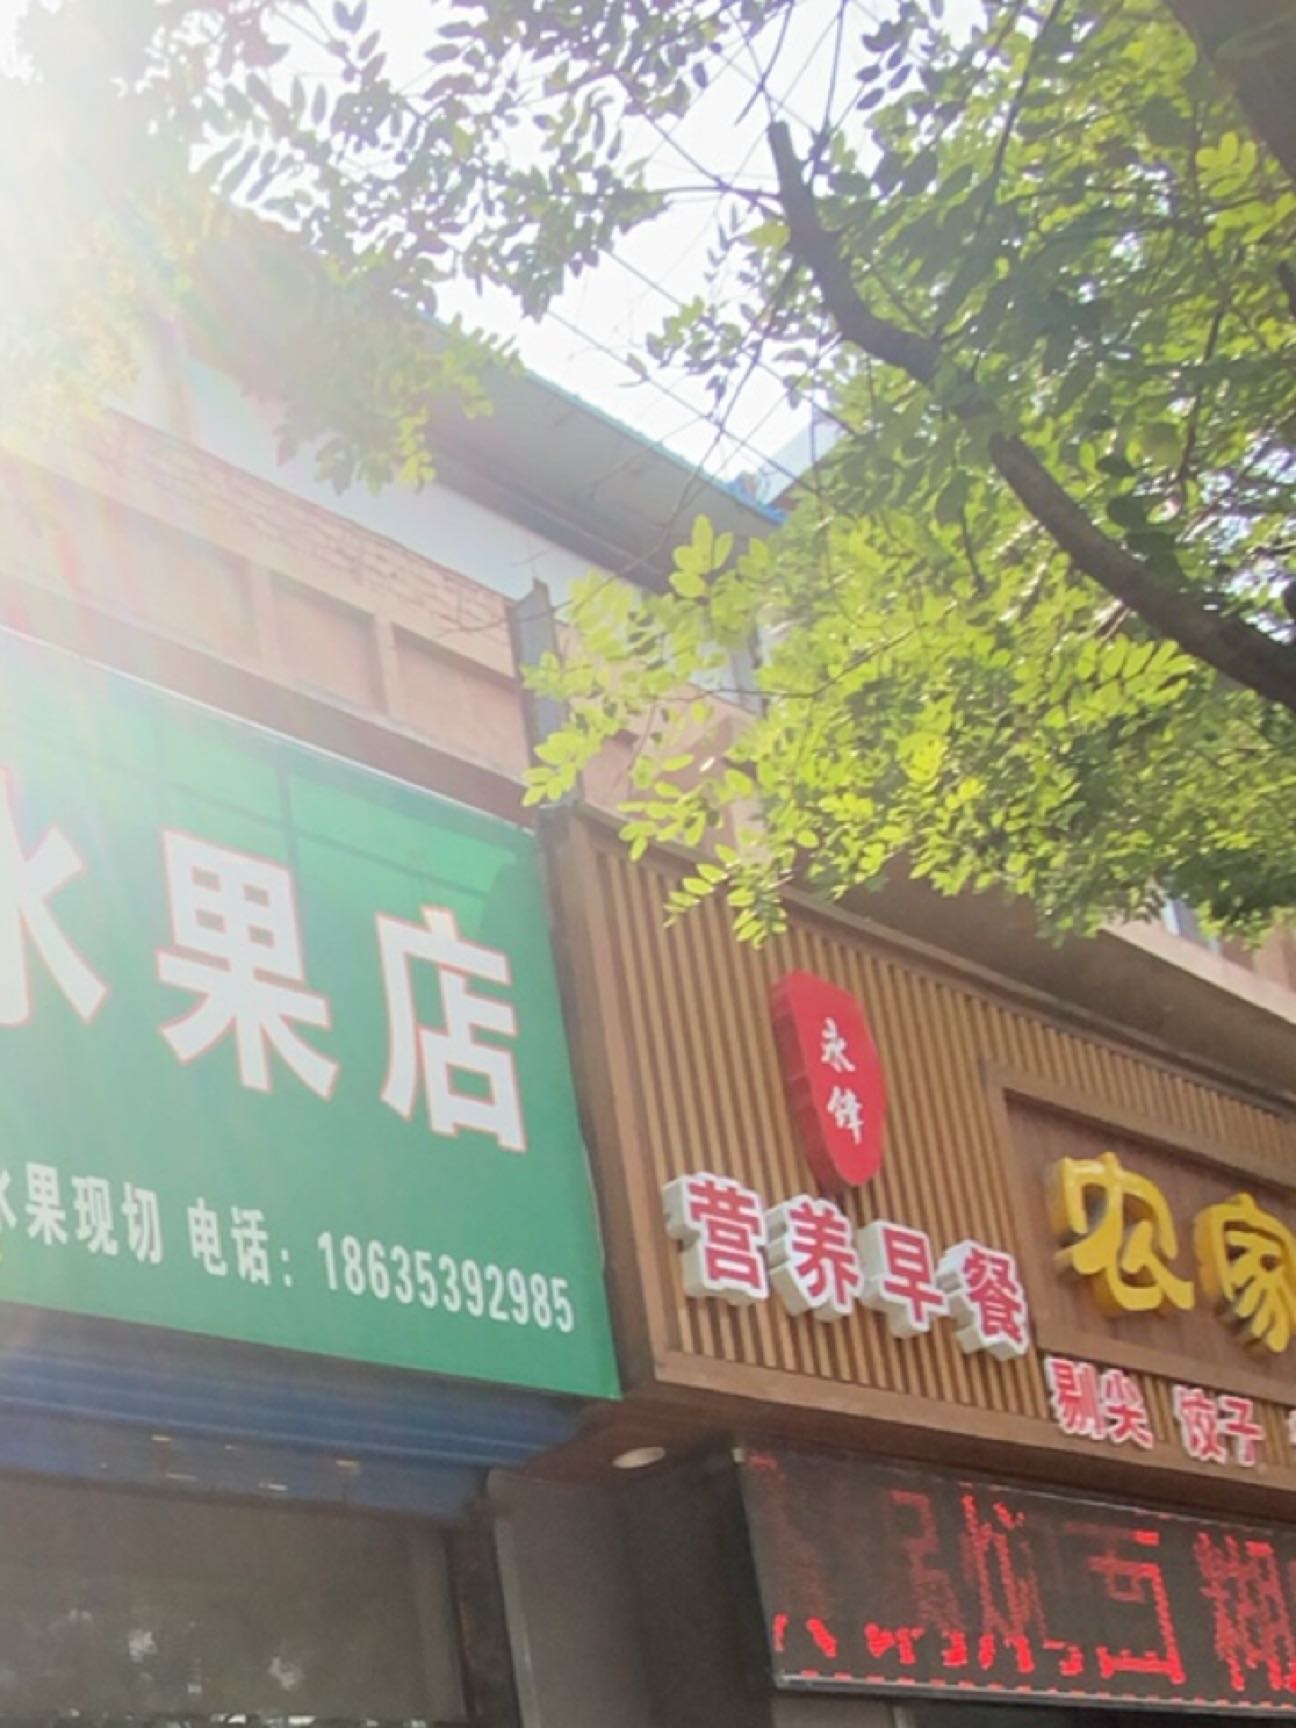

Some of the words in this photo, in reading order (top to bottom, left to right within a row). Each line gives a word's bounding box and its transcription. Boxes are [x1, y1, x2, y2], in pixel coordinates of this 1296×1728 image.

[317, 1230, 575, 1333] 18635392985
[672, 1172, 1030, 1360] 营养早餐
[1052, 1153, 1296, 1356] 农家
[1046, 1356, 1153, 1449] 剔尖
[1173, 1384, 1265, 1467] 饺子
